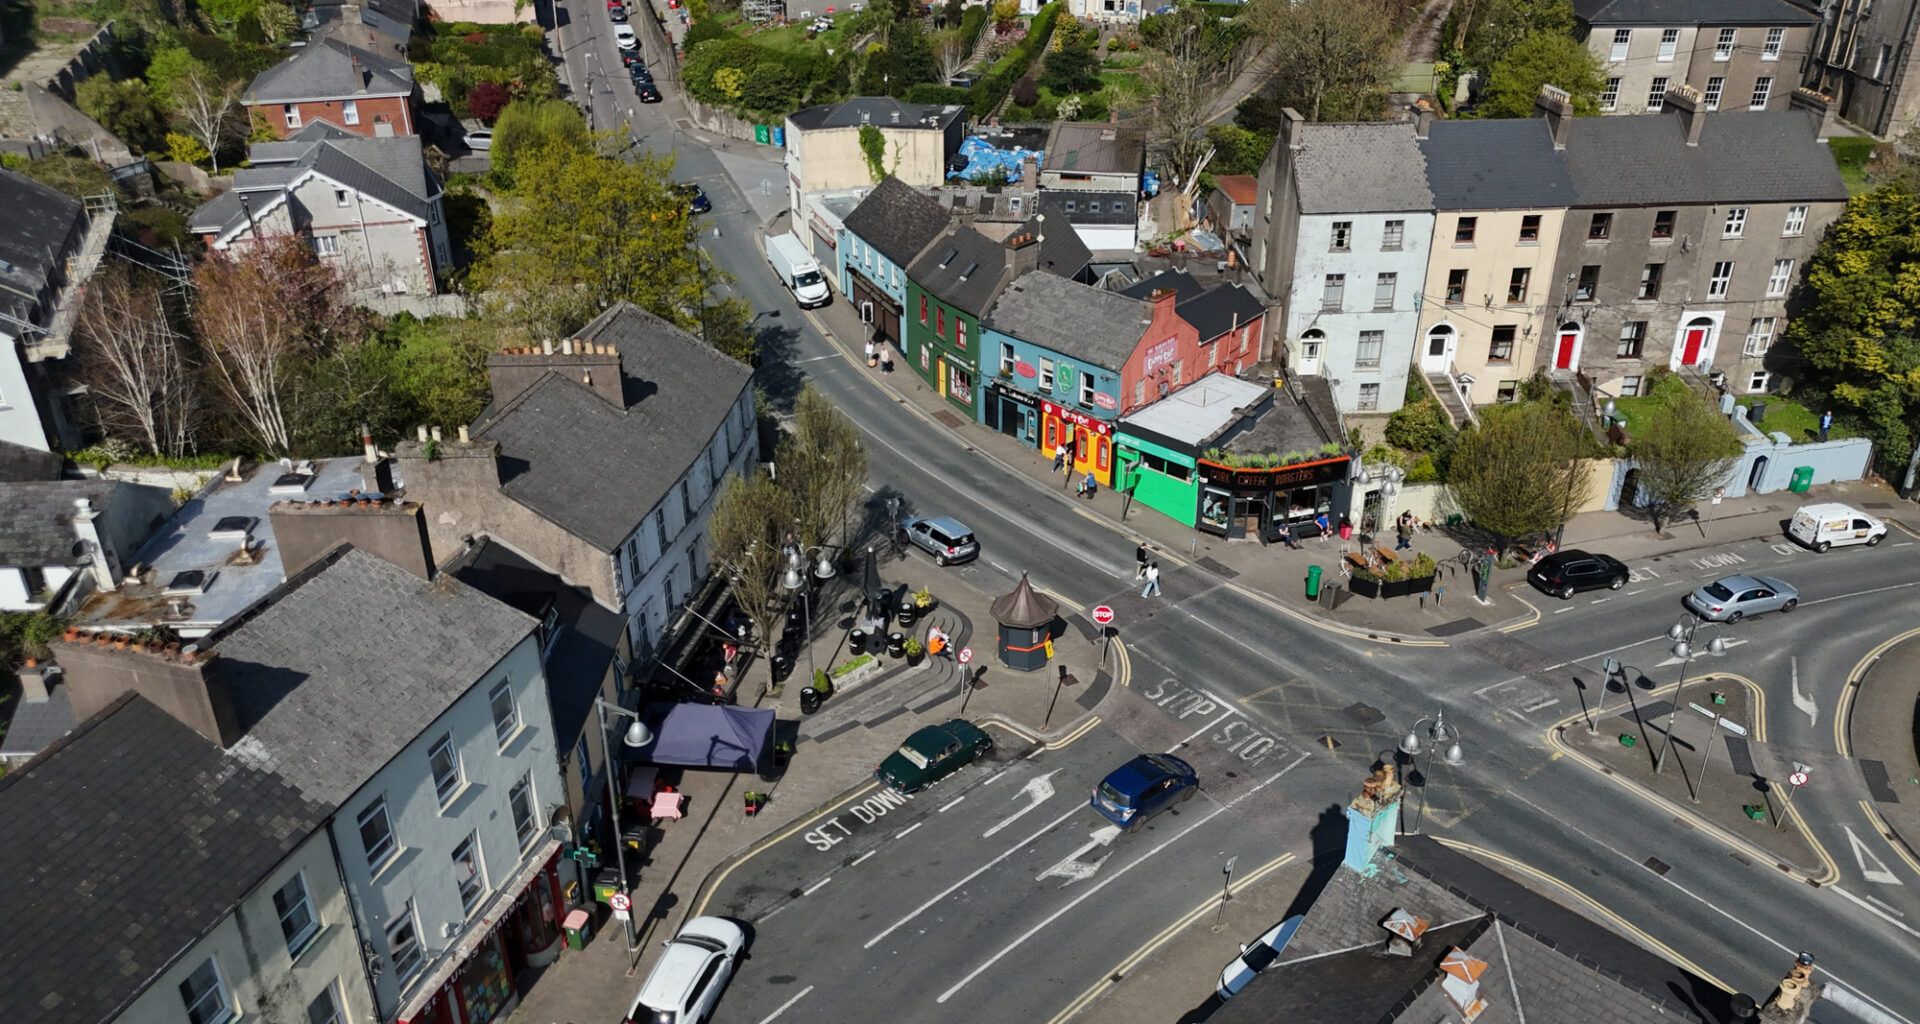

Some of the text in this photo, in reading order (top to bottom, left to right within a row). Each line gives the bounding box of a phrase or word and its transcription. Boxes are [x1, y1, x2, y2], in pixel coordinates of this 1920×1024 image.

[1238, 475, 1268, 486] COFFEE
[1274, 469, 1314, 485] ROASTERS
[1690, 552, 1746, 570] DOWN
[1144, 678, 1217, 720] STOP
[1212, 720, 1290, 767] STOP
[804, 787, 915, 852] SET DOWN
